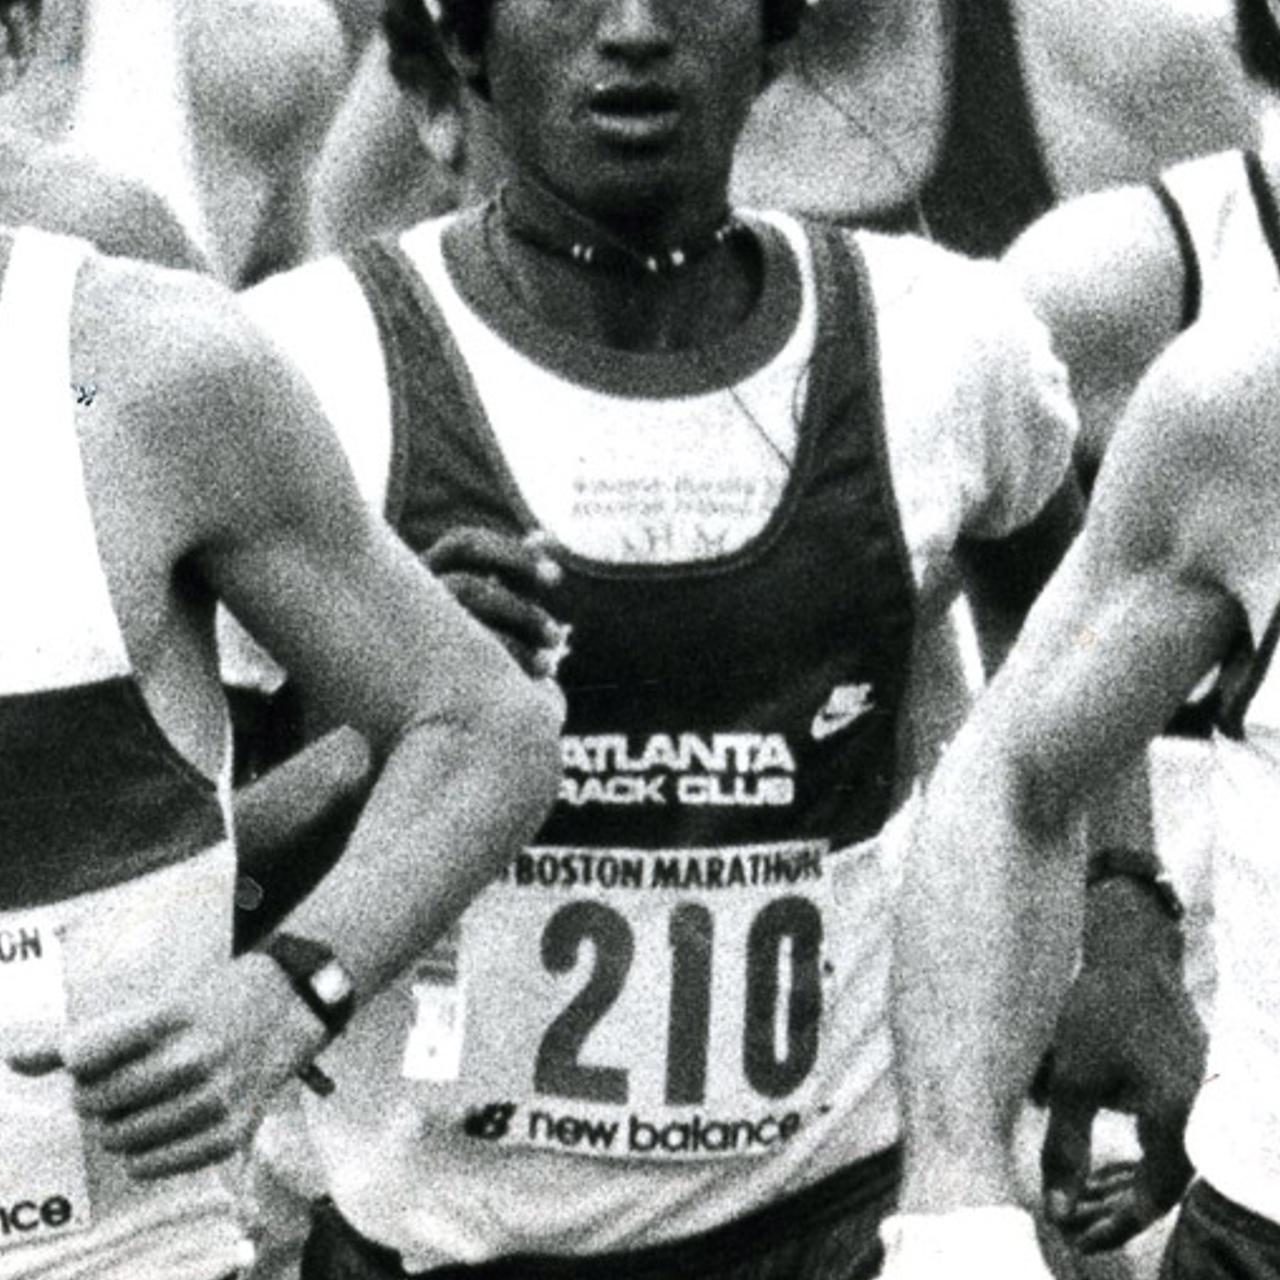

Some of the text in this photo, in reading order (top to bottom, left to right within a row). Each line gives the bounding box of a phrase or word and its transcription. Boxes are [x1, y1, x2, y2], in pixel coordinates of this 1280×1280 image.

[560, 732, 797, 772] ATLANTA
[677, 775, 796, 806] CLUB
[515, 848, 822, 890] BOSTON MARATHON
[533, 894, 824, 1107] 210
[528, 1111, 619, 1149] new
[629, 1112, 801, 1152] balance
